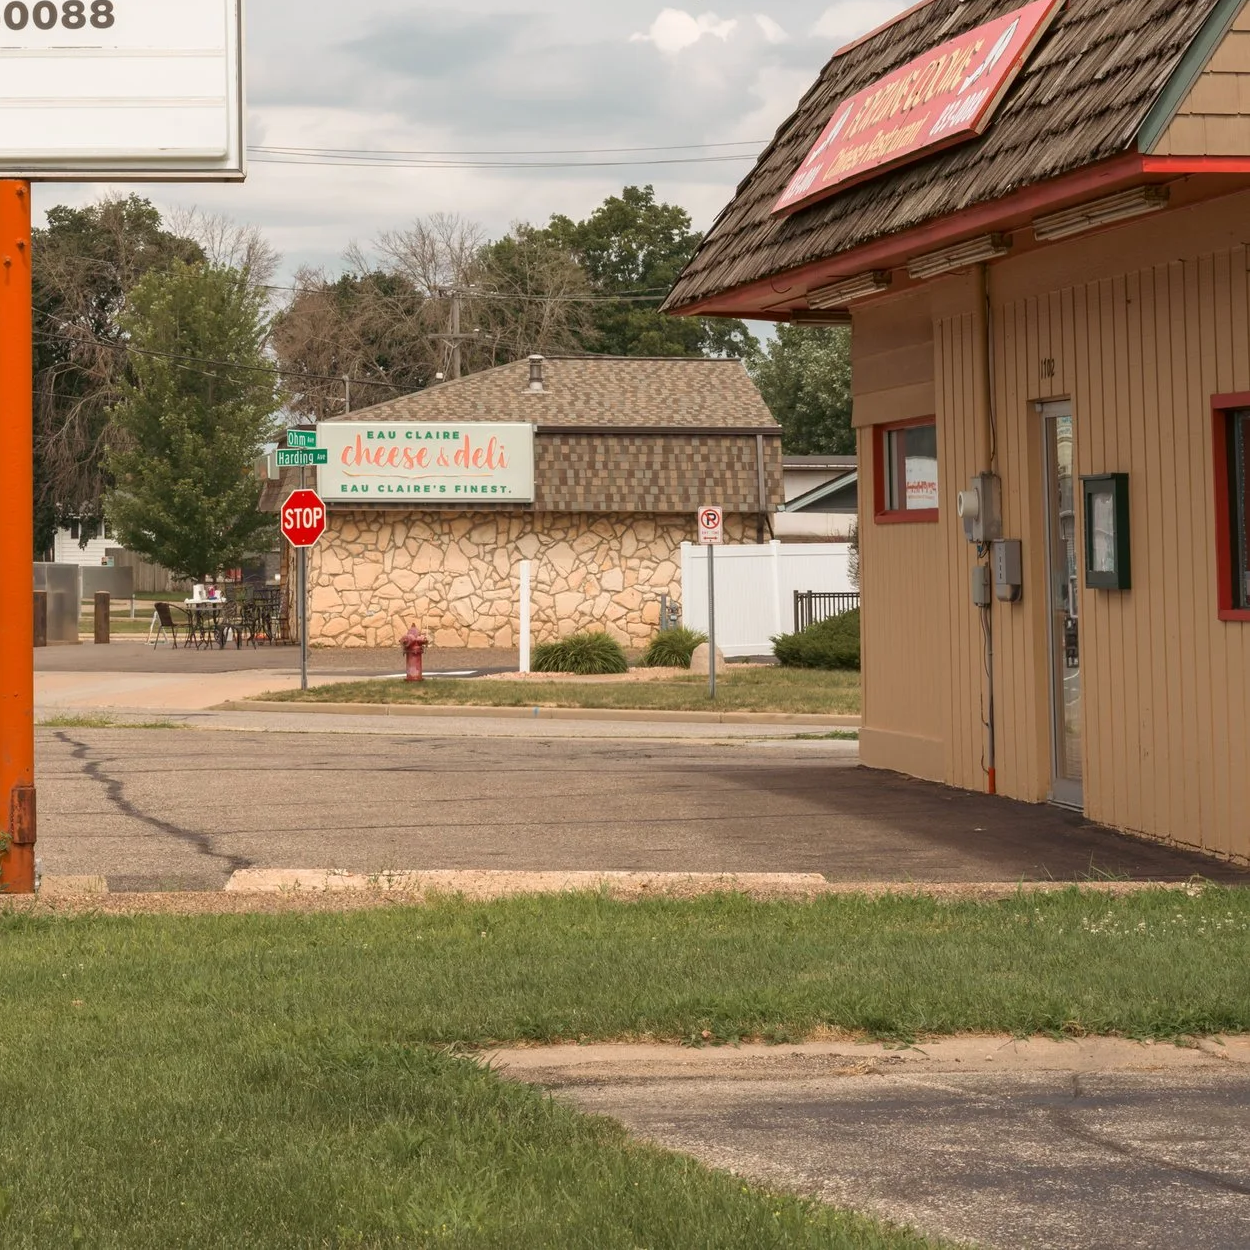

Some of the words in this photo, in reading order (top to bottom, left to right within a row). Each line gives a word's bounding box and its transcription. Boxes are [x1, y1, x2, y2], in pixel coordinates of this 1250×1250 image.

[841, 68, 921, 142] FORTUNE
[902, 38, 986, 114] COOKIE
[288, 432, 306, 446] Ohm
[366, 431, 396, 439] EAU
[405, 431, 460, 440] CLAIRE
[278, 451, 314, 464] Harding
[341, 434, 432, 470] cheese
[436, 446, 450, 468] &
[454, 434, 510, 470] deli
[341, 484, 369, 492] EAU
[377, 484, 446, 493] CLAIRE'S
[454, 485, 512, 494] FINEST.
[284, 507, 322, 530] STOP
